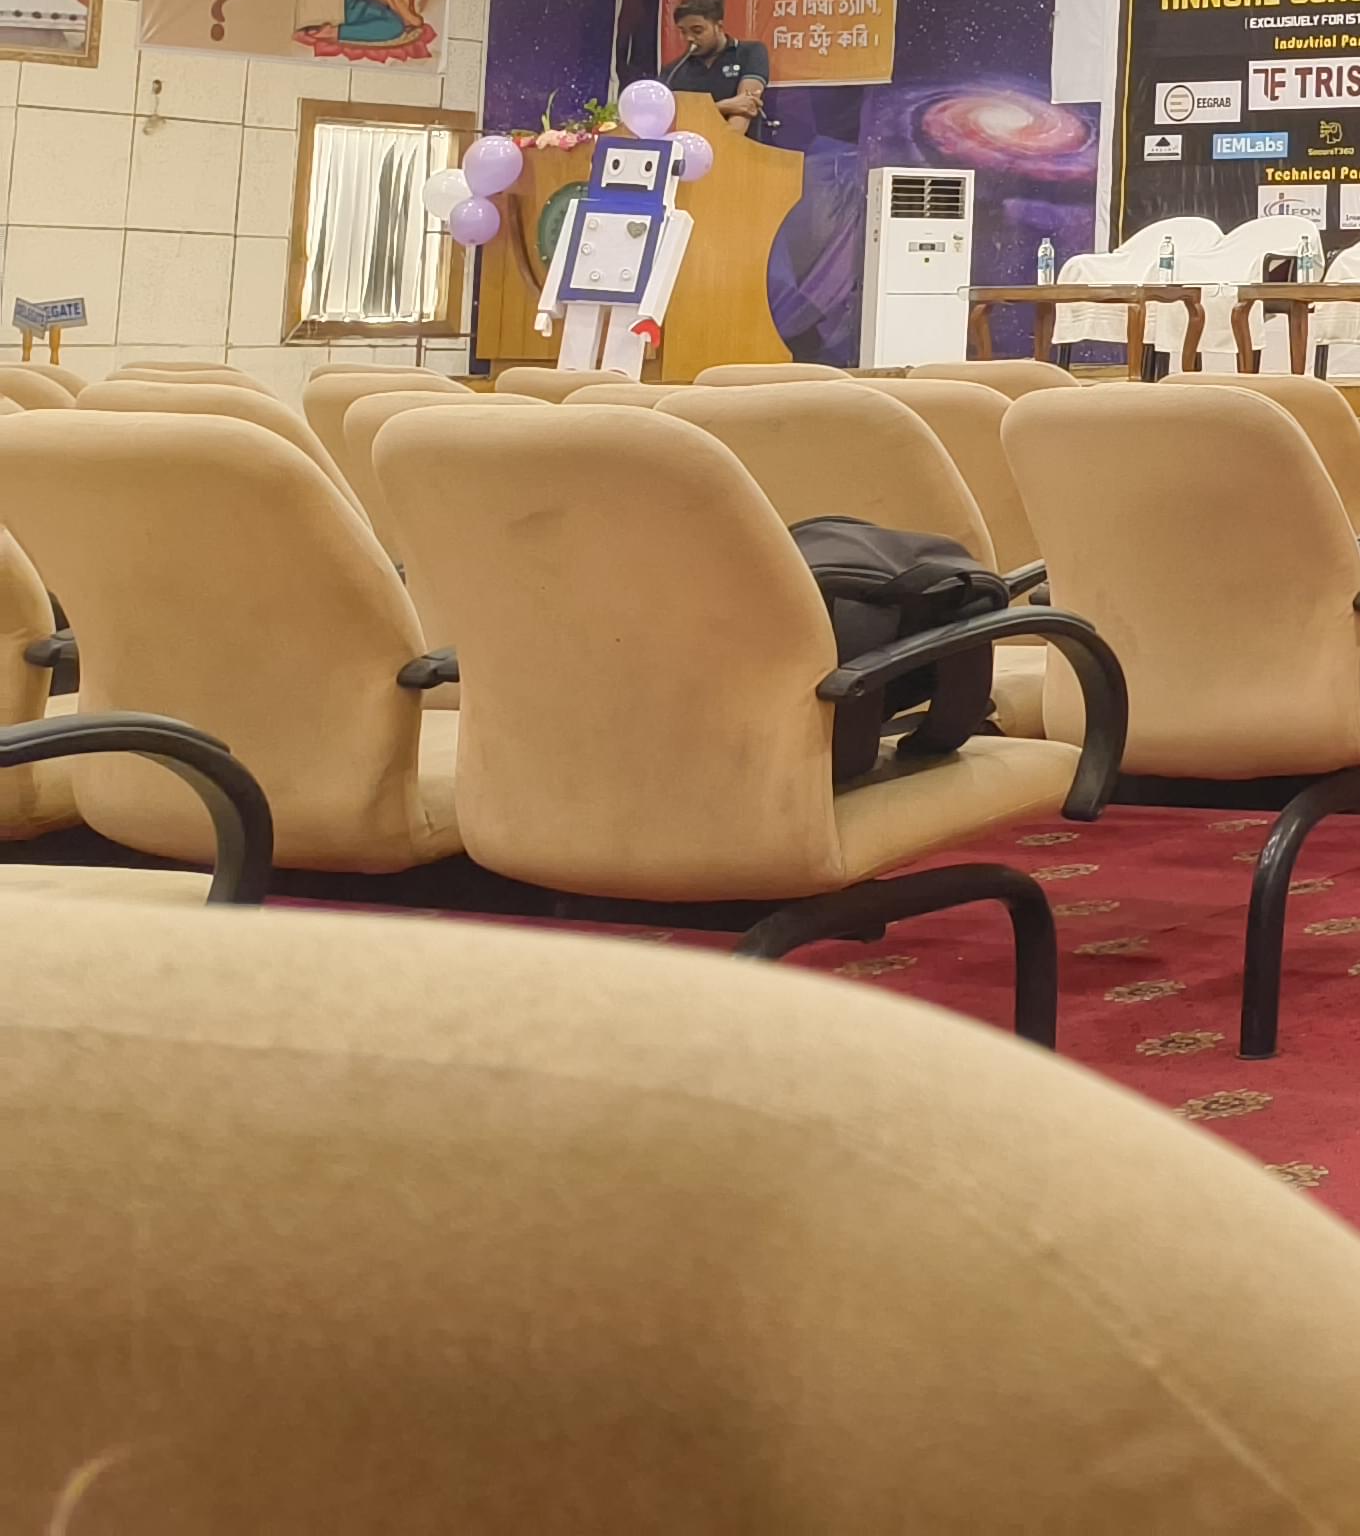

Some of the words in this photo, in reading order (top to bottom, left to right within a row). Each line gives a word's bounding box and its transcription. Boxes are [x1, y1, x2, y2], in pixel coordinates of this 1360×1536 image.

[1321, 13, 1344, 26] FOR
[773, 25, 805, 50] শির
[809, 21, 832, 56] উঁচু
[837, 23, 869, 49] করি
[1274, 34, 1337, 50] Industrial
[1196, 97, 1232, 109] EEGRAB
[1217, 136, 1284, 154] IEMLabs
[1265, 167, 1337, 182] Technical
